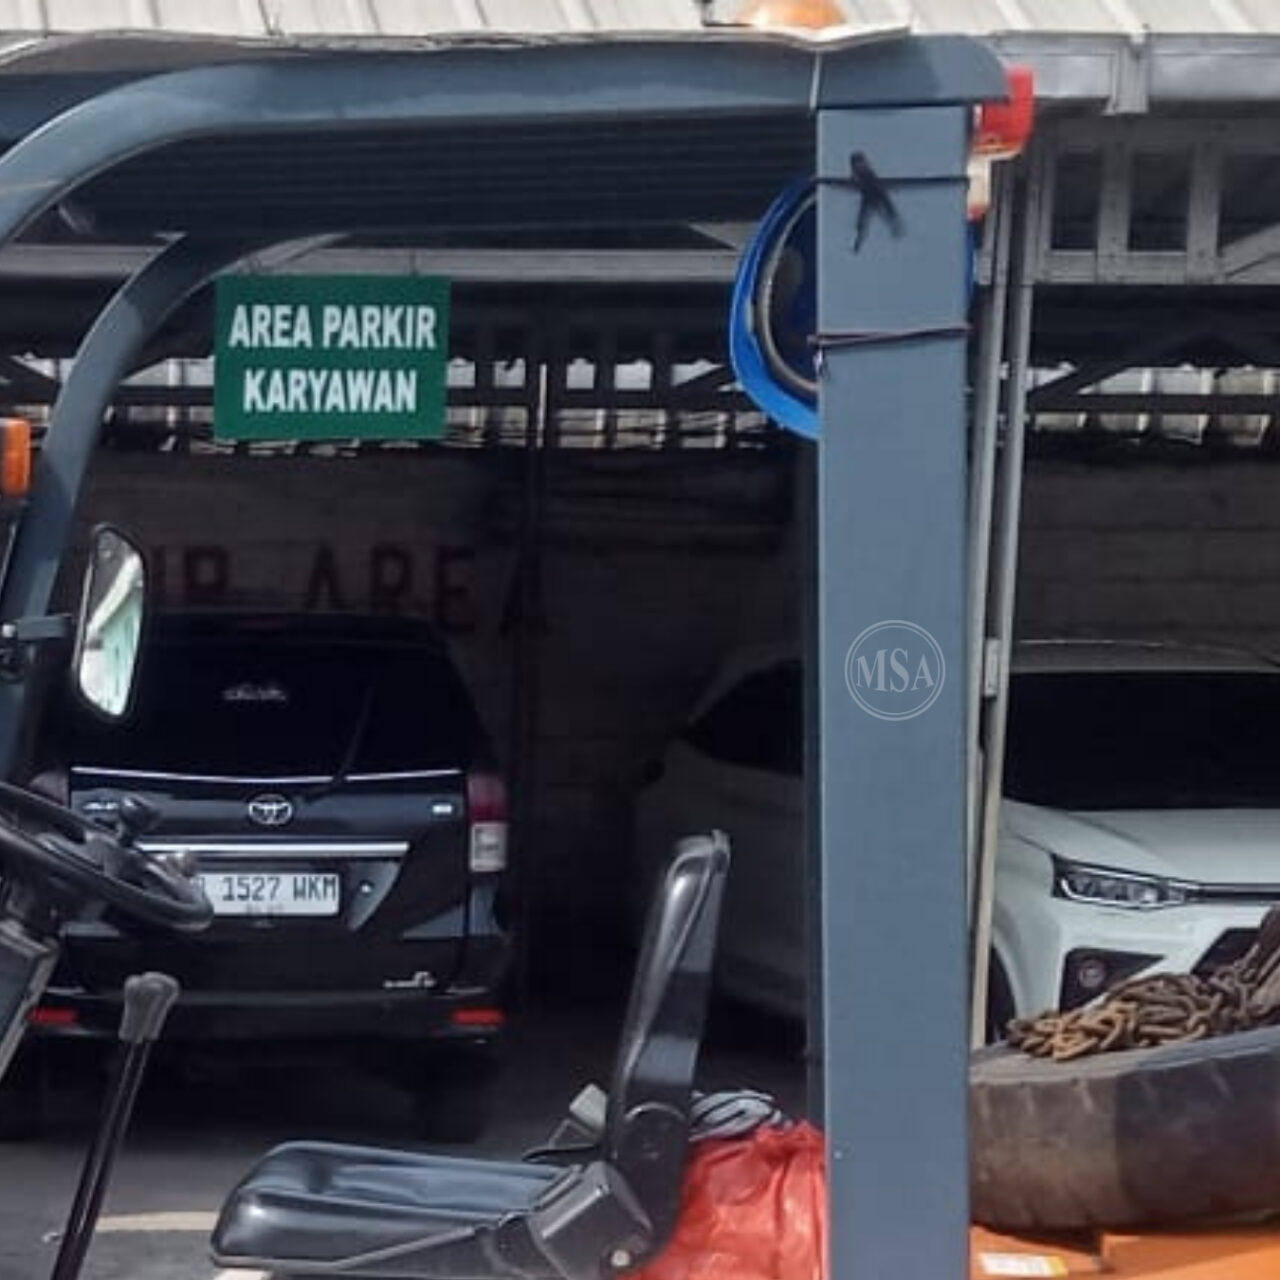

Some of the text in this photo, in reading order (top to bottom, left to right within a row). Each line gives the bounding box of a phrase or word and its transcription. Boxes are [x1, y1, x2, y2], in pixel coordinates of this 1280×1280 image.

[229, 304, 436, 349] AREA PARKIR
[243, 369, 417, 413] KARYAWAN
[221, 876, 281, 901] 1527
[293, 876, 337, 901] WKM
